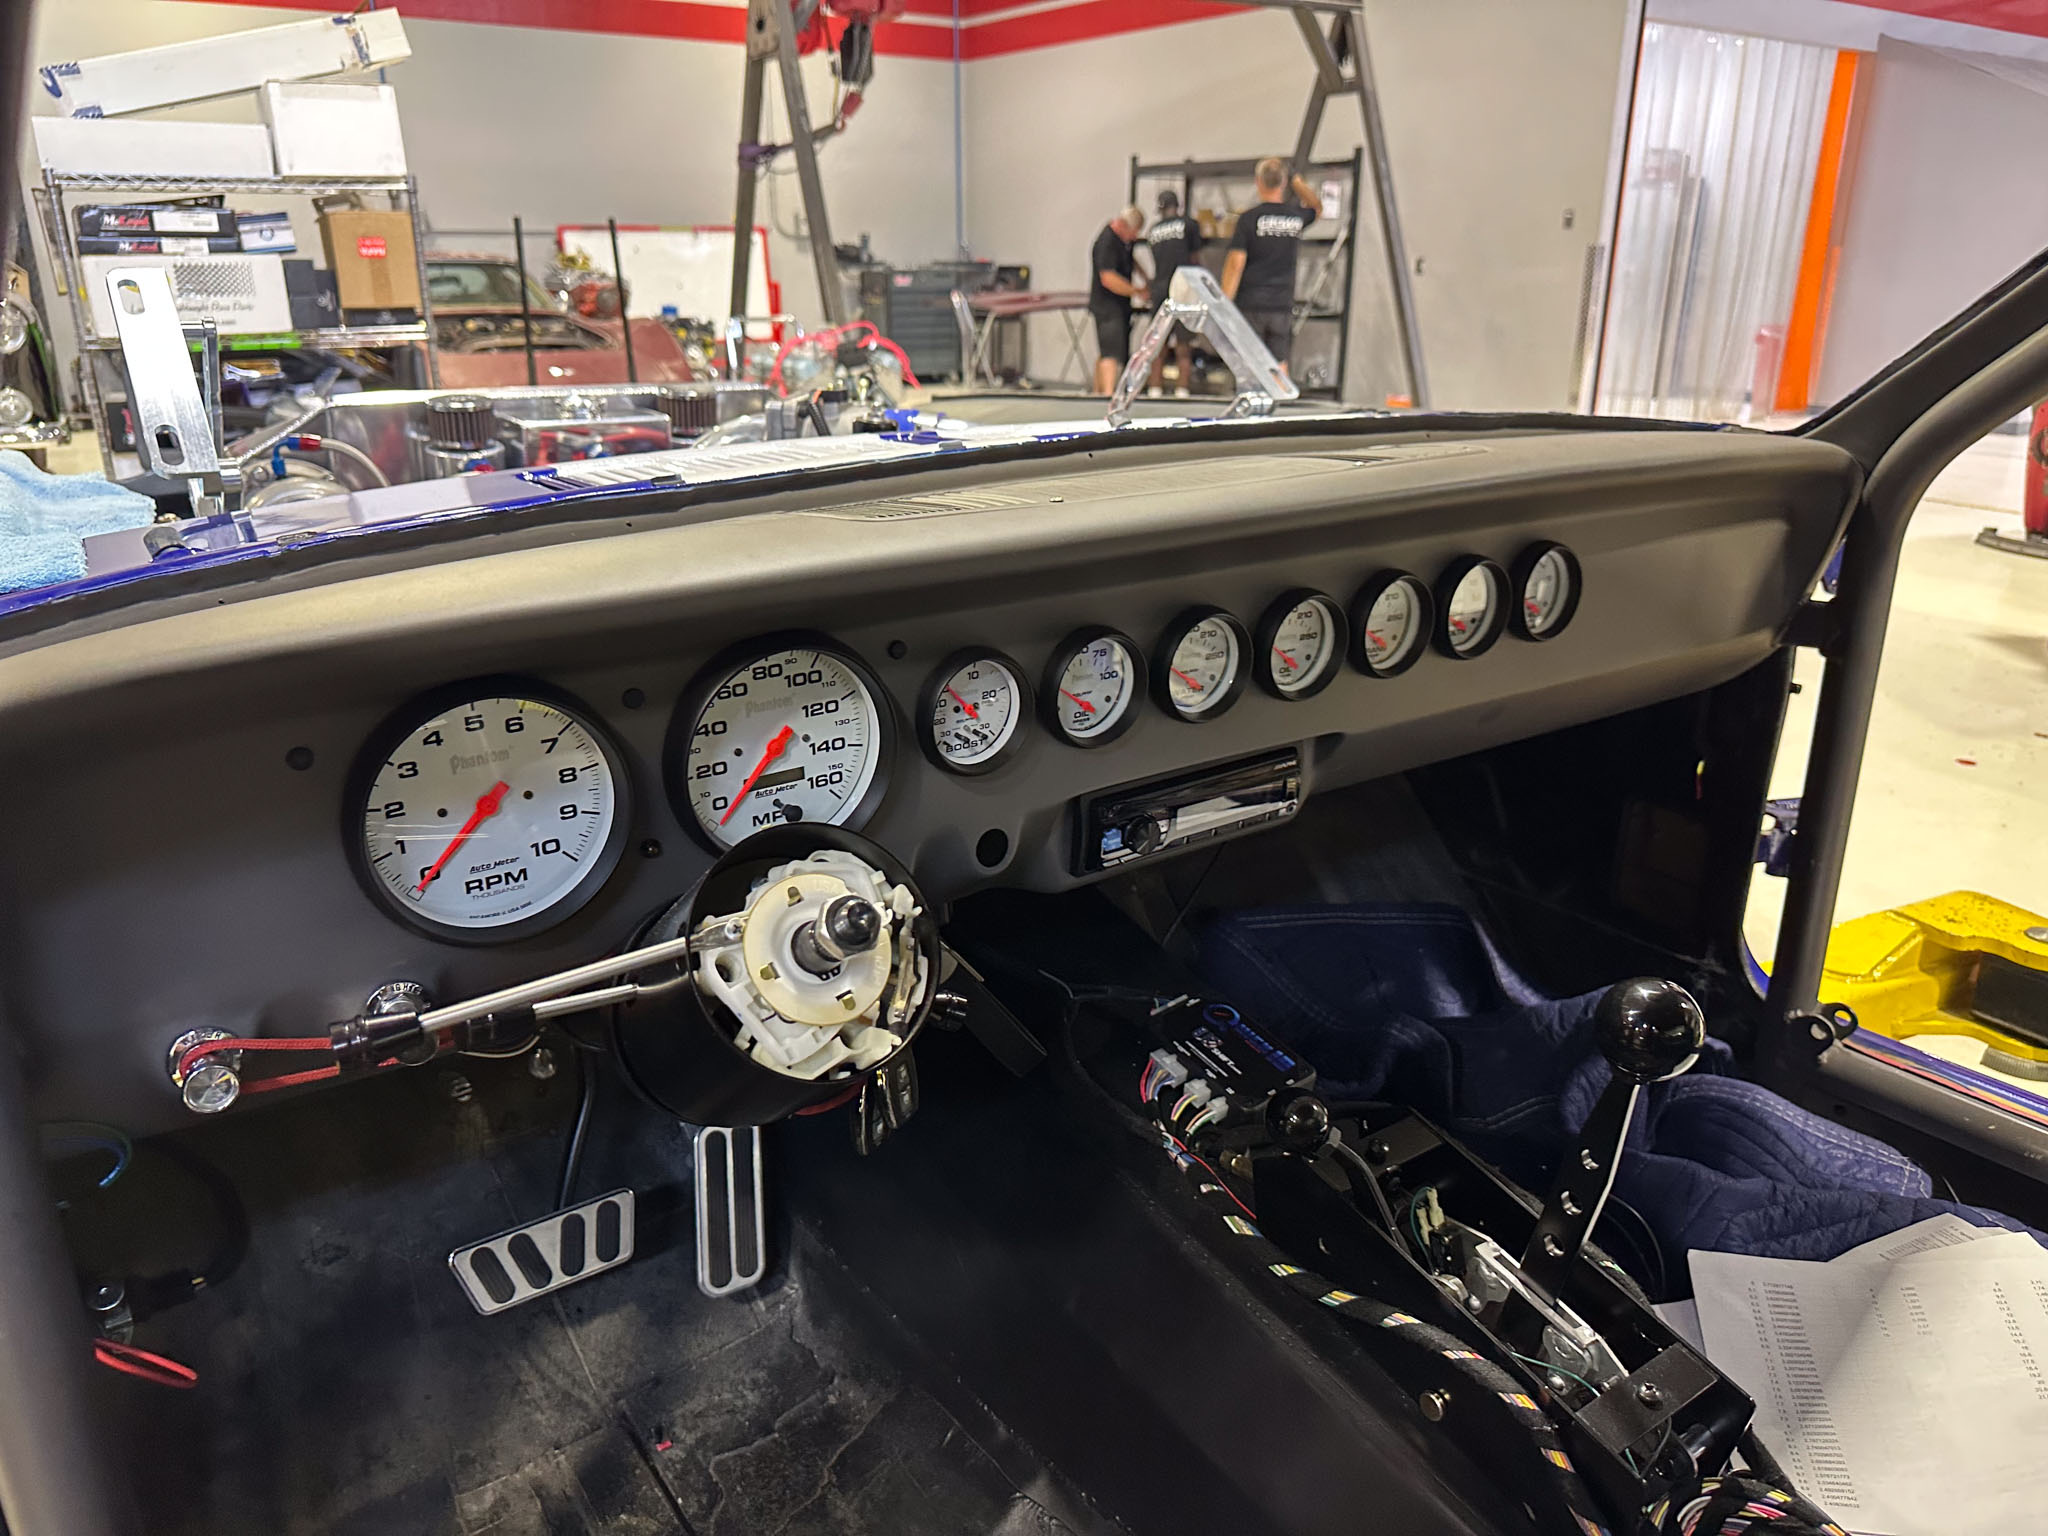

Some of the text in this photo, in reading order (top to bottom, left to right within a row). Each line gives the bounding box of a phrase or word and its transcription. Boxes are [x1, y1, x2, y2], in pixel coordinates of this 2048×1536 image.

[1200, 630, 1217, 639] 210
[784, 657, 798, 665] 90
[1092, 648, 1107, 658] 75
[752, 663, 783, 681] 80
[784, 669, 822, 688] 100
[967, 671, 980, 680] 10
[1100, 670, 1118, 680] 100
[717, 682, 748, 700] 60
[821, 680, 837, 688] 110
[981, 689, 997, 700] 20
[801, 699, 839, 718] 120
[464, 714, 485, 732] 5
[504, 716, 525, 734] 6
[694, 720, 727, 737] 40
[834, 718, 851, 726] 130
[422, 730, 444, 747] 4
[540, 736, 559, 754] 7
[809, 737, 846, 755] 140
[945, 740, 984, 753] BOOST
[397, 761, 419, 779] 3
[558, 767, 578, 784] 8
[695, 761, 728, 780] 20
[828, 763, 844, 771] 150
[807, 770, 843, 790] 160
[700, 791, 711, 799] 10
[755, 783, 798, 799] Auto Meter
[384, 801, 406, 820] 2
[559, 803, 578, 821] 9
[712, 796, 728, 811] 0
[394, 838, 407, 854] 1
[530, 838, 561, 858] 10
[419, 865, 441, 883] 0
[469, 856, 520, 875] Auto Meter
[464, 867, 528, 895] RPM
[472, 883, 525, 901] THOUSANDS
